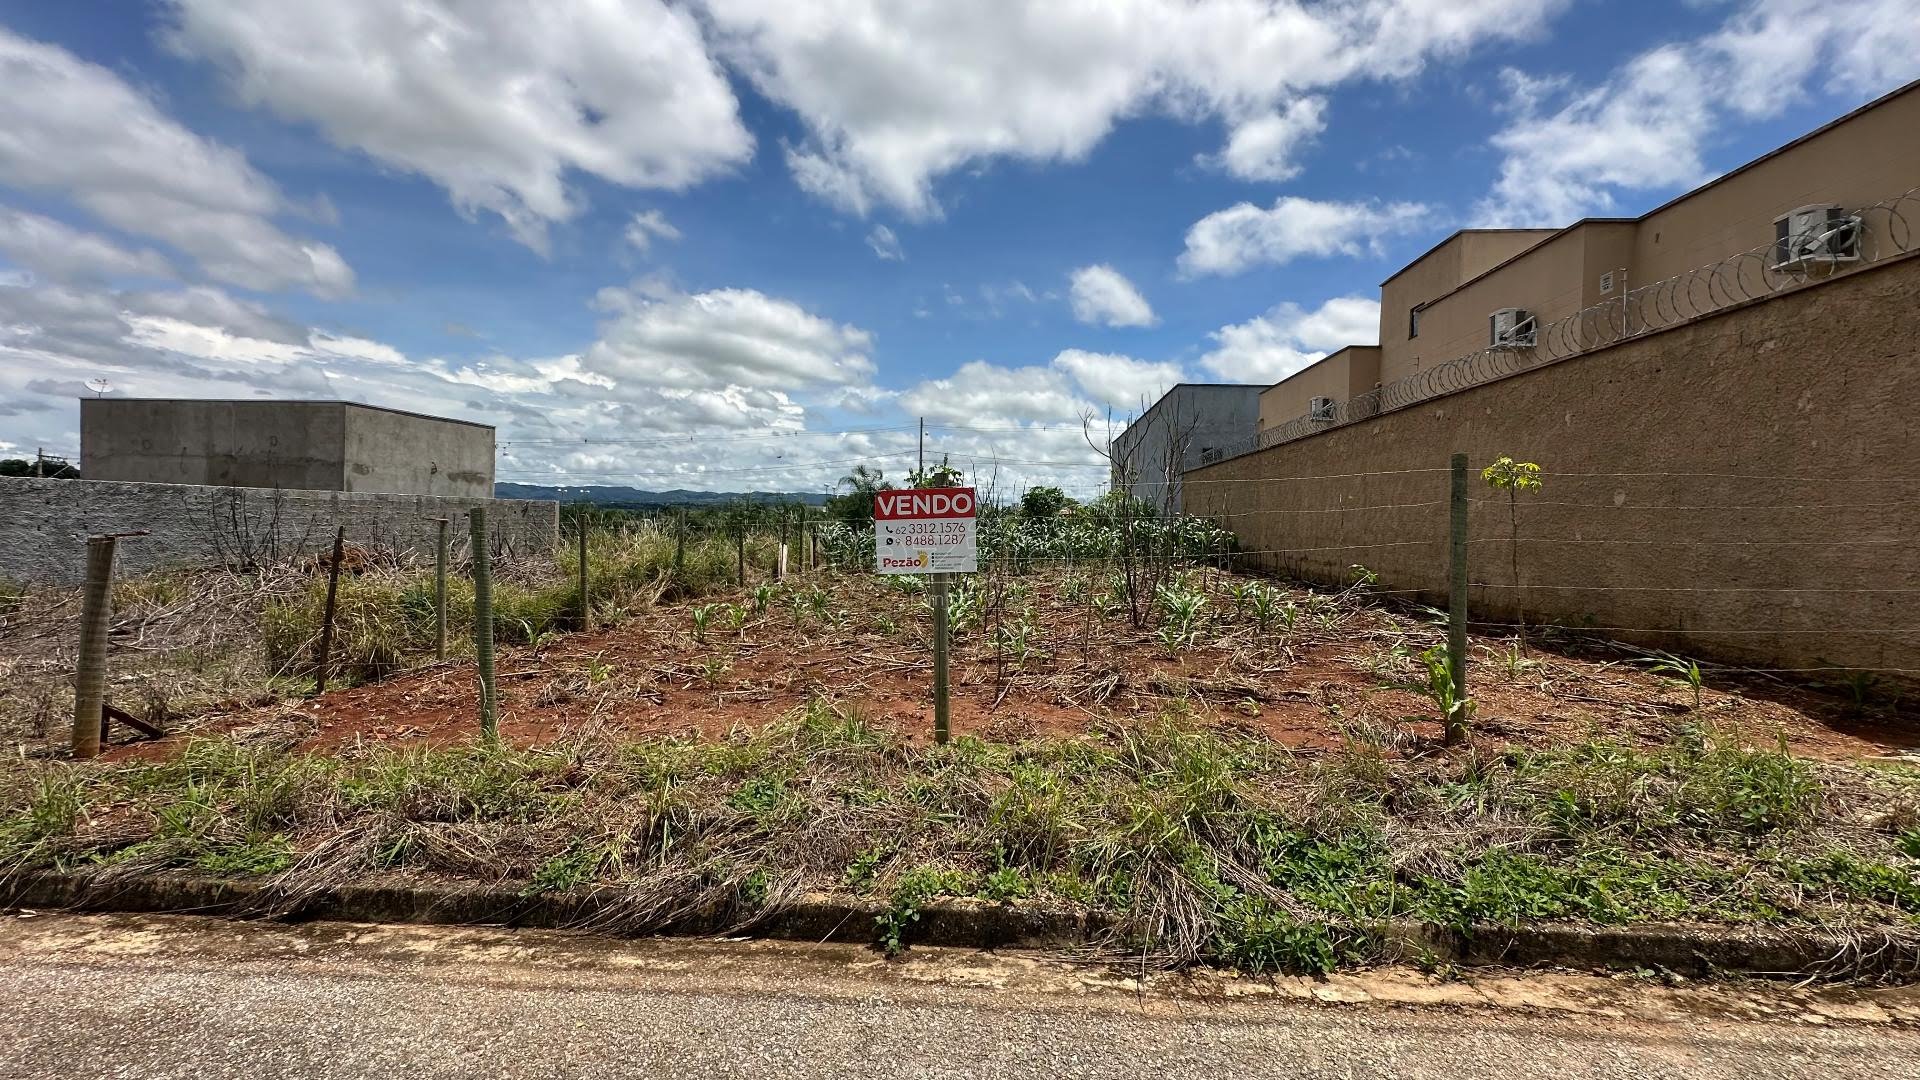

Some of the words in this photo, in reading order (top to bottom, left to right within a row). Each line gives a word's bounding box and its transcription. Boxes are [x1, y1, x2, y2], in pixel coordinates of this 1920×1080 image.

[877, 493, 972, 516] VENDO
[895, 526, 907, 535] 62
[908, 522, 966, 534] 3312.1576
[905, 534, 966, 546] 8488.1287
[882, 557, 922, 568] Pezão
